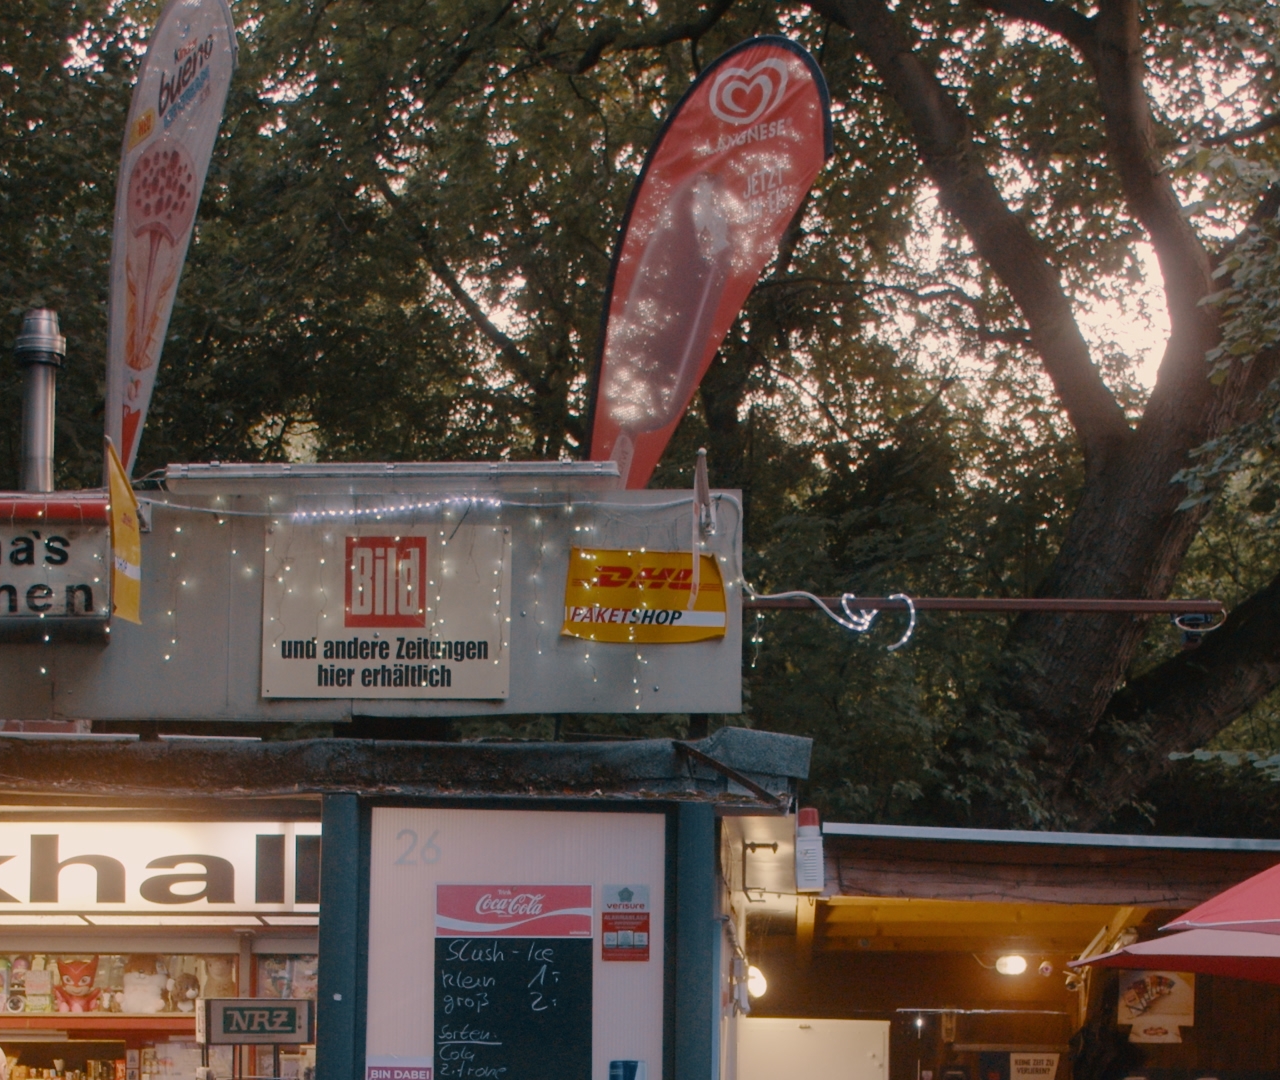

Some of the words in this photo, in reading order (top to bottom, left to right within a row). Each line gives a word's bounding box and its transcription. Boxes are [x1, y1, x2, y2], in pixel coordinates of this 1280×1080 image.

[158, 34, 213, 118] bueno
[705, 119, 785, 155] LANGNESE
[352, 545, 421, 616] Bild
[595, 565, 697, 590] DHL
[571, 607, 682, 625] PAKETSHOP
[281, 638, 317, 659] und
[323, 638, 390, 659] andere
[396, 637, 488, 662] Zeitungen
[317, 665, 355, 687] hier
[361, 664, 451, 687] erhältlich
[475, 893, 545, 915] Coca-Cola
[226, 1010, 293, 1031] NRZ
[440, 1044, 474, 1061] Cola
[371, 1069, 391, 1080] BIN
[394, 1068, 429, 1080] DABEI
